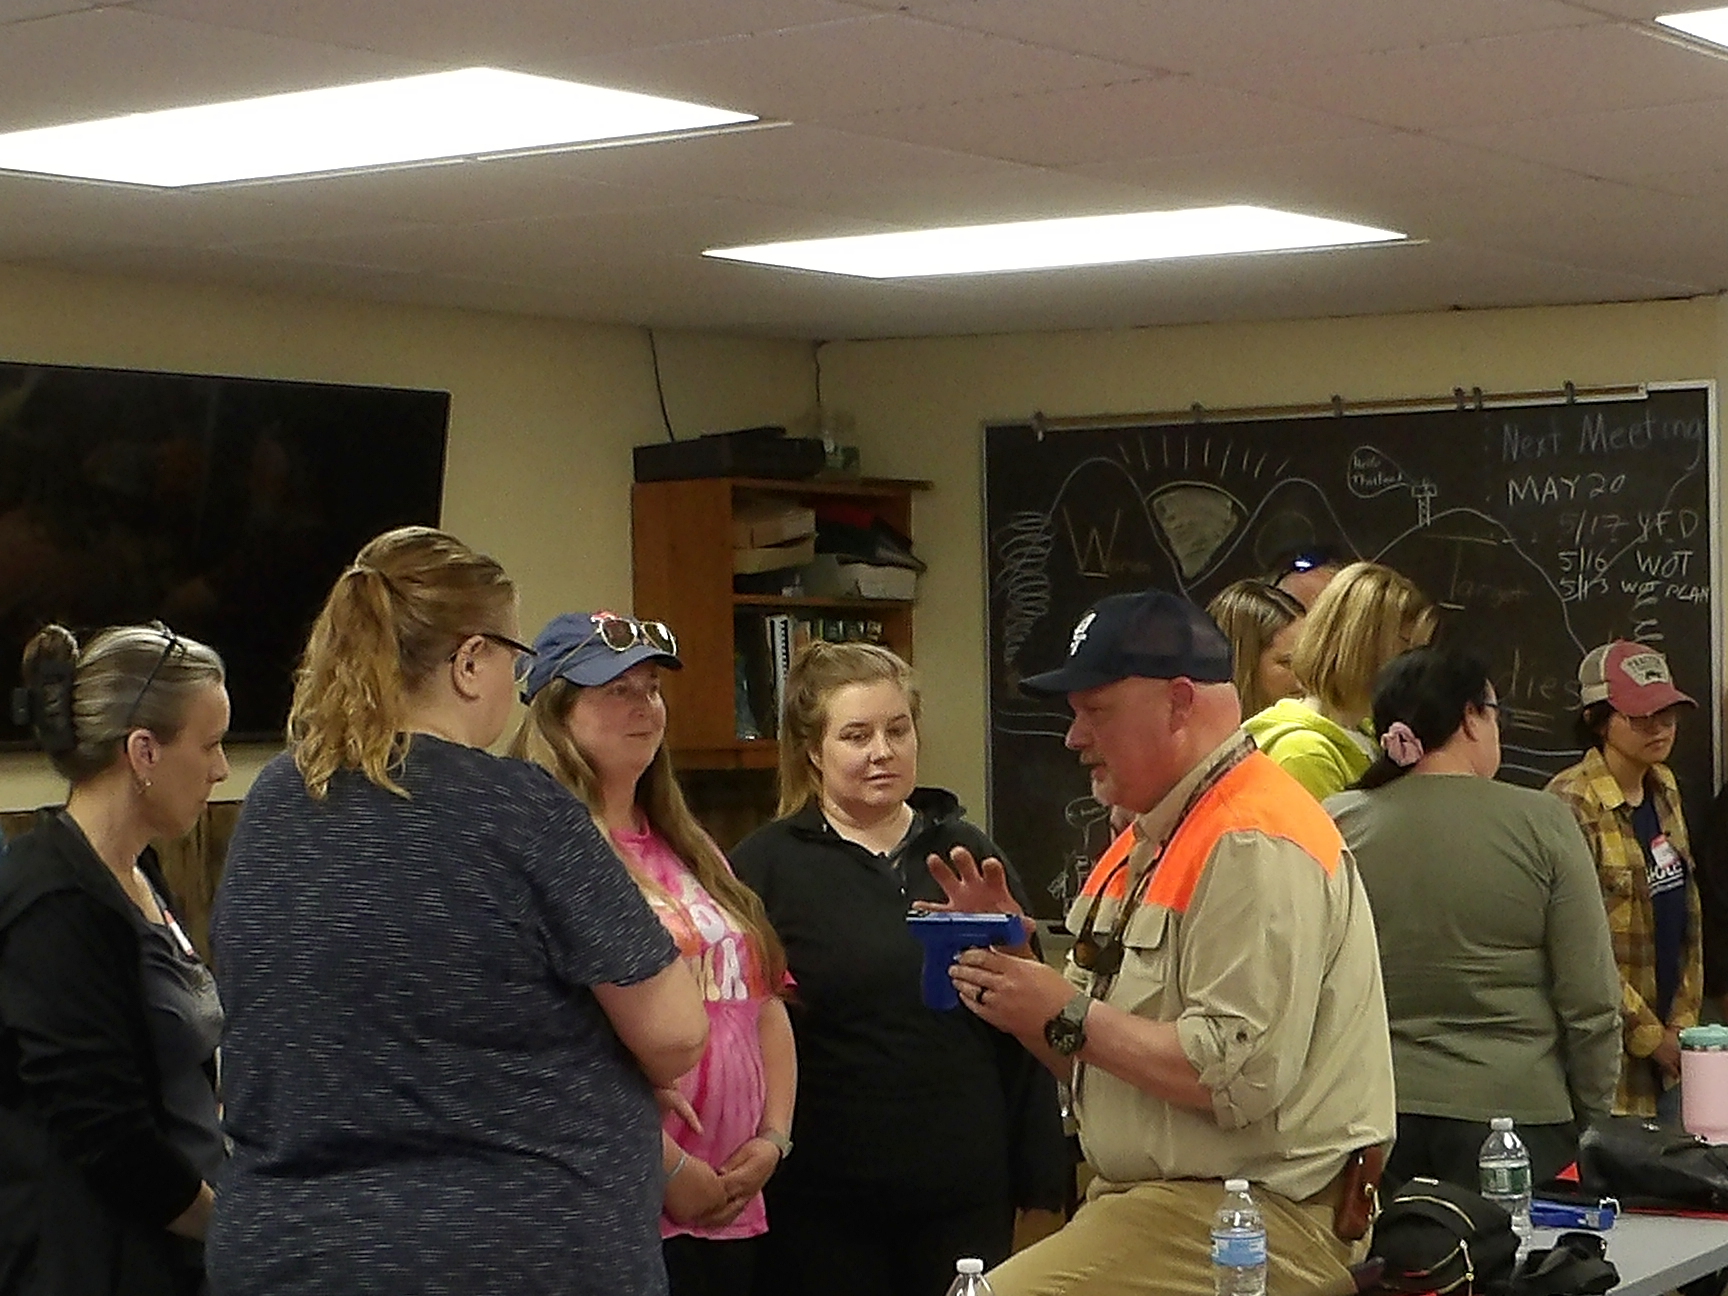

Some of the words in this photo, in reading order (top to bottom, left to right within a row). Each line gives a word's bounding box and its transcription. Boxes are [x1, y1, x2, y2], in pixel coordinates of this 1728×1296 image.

[1503, 423, 1560, 462] Next
[1579, 409, 1704, 472] Meeting
[1508, 475, 1580, 506] MAY
[1586, 473, 1626, 499] 20
[1636, 551, 1694, 577] WOT
